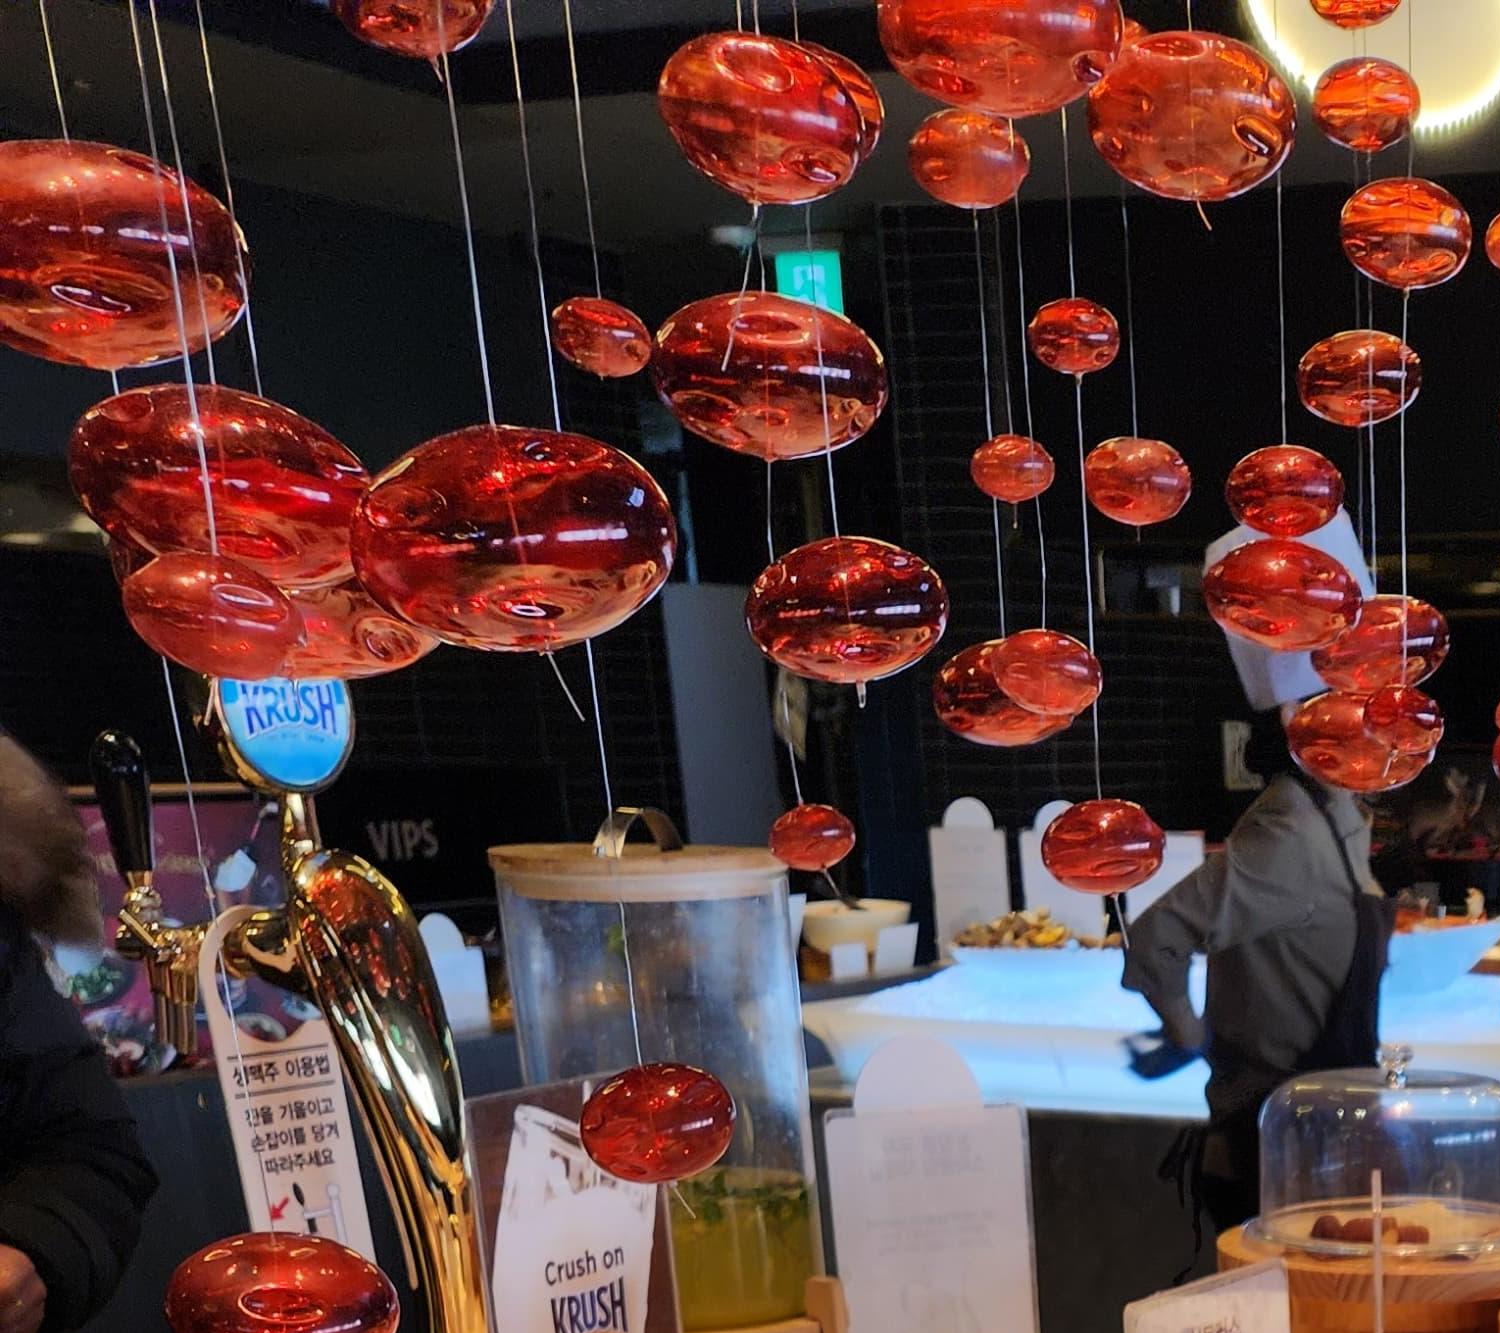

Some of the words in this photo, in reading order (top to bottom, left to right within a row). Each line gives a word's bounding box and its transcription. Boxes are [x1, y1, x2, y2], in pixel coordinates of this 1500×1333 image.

[240, 682, 337, 735] KRUSH
[366, 818, 439, 862] VIPS
[233, 1061, 280, 1087] 생맥주
[285, 1054, 331, 1078] 이용법
[279, 1097, 335, 1122] 기울이고
[251, 1128, 307, 1153] 손잡이를
[263, 1149, 336, 1176] 따라주세요
[545, 1250, 597, 1287] Crush
[602, 1247, 625, 1269] on
